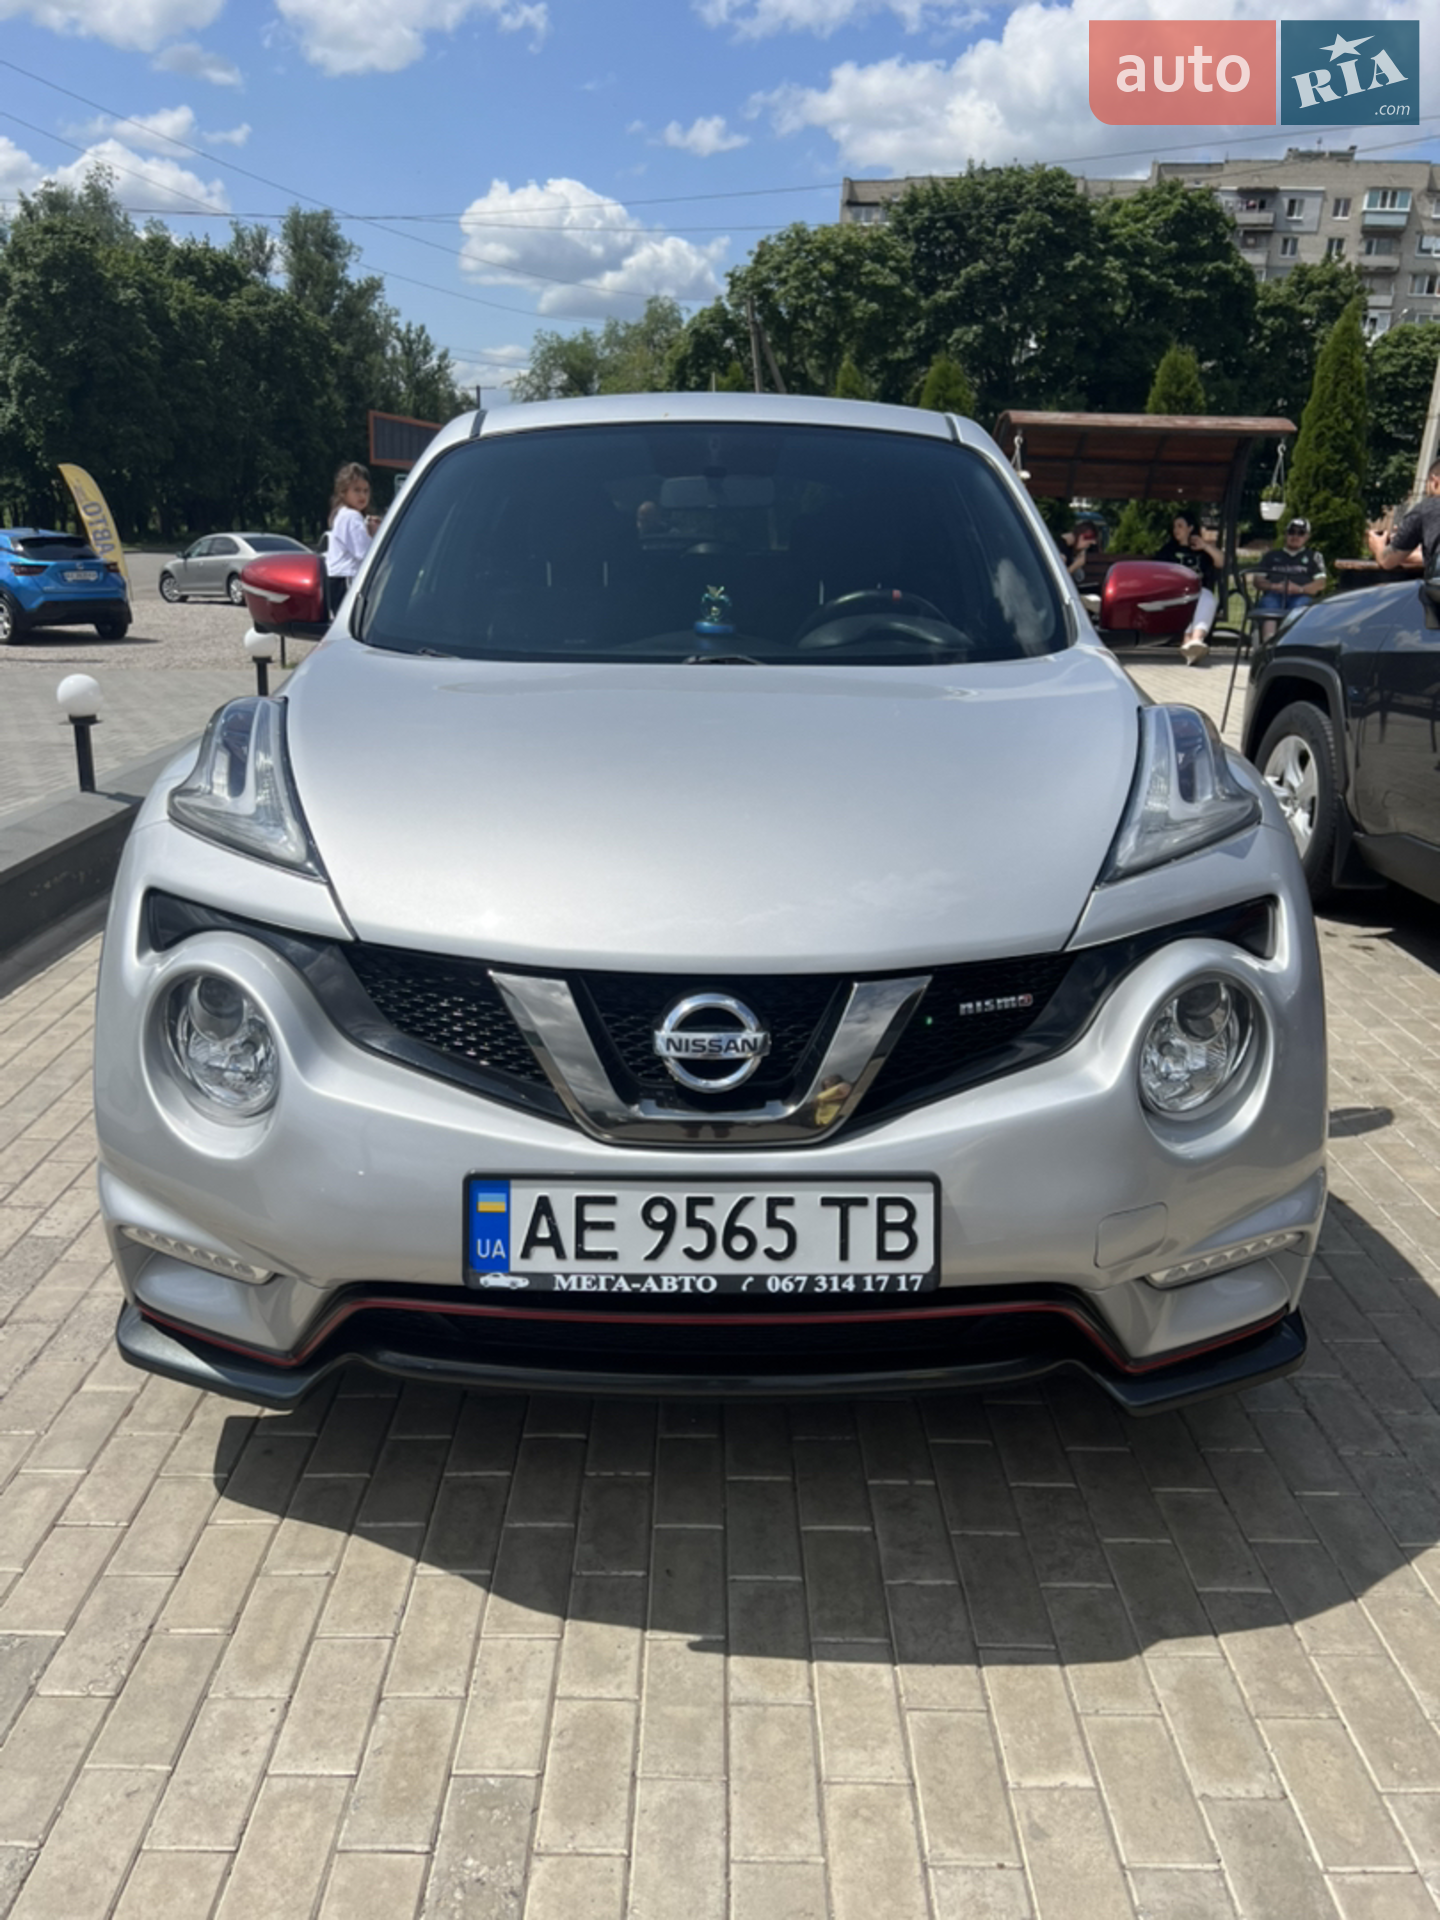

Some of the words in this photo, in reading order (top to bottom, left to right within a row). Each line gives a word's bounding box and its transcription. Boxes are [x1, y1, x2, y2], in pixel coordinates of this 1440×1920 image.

[665, 1037, 758, 1054] NISSAN
[519, 1194, 619, 1261] AE
[640, 1195, 798, 1261] 9565
[819, 1195, 919, 1262] TB
[476, 1238, 507, 1260] UA
[552, 1273, 718, 1293] МЕГА-АВТО
[766, 1275, 808, 1293] 067
[814, 1275, 856, 1293] 314
[863, 1275, 890, 1292] 17
[896, 1275, 924, 1292] 17
